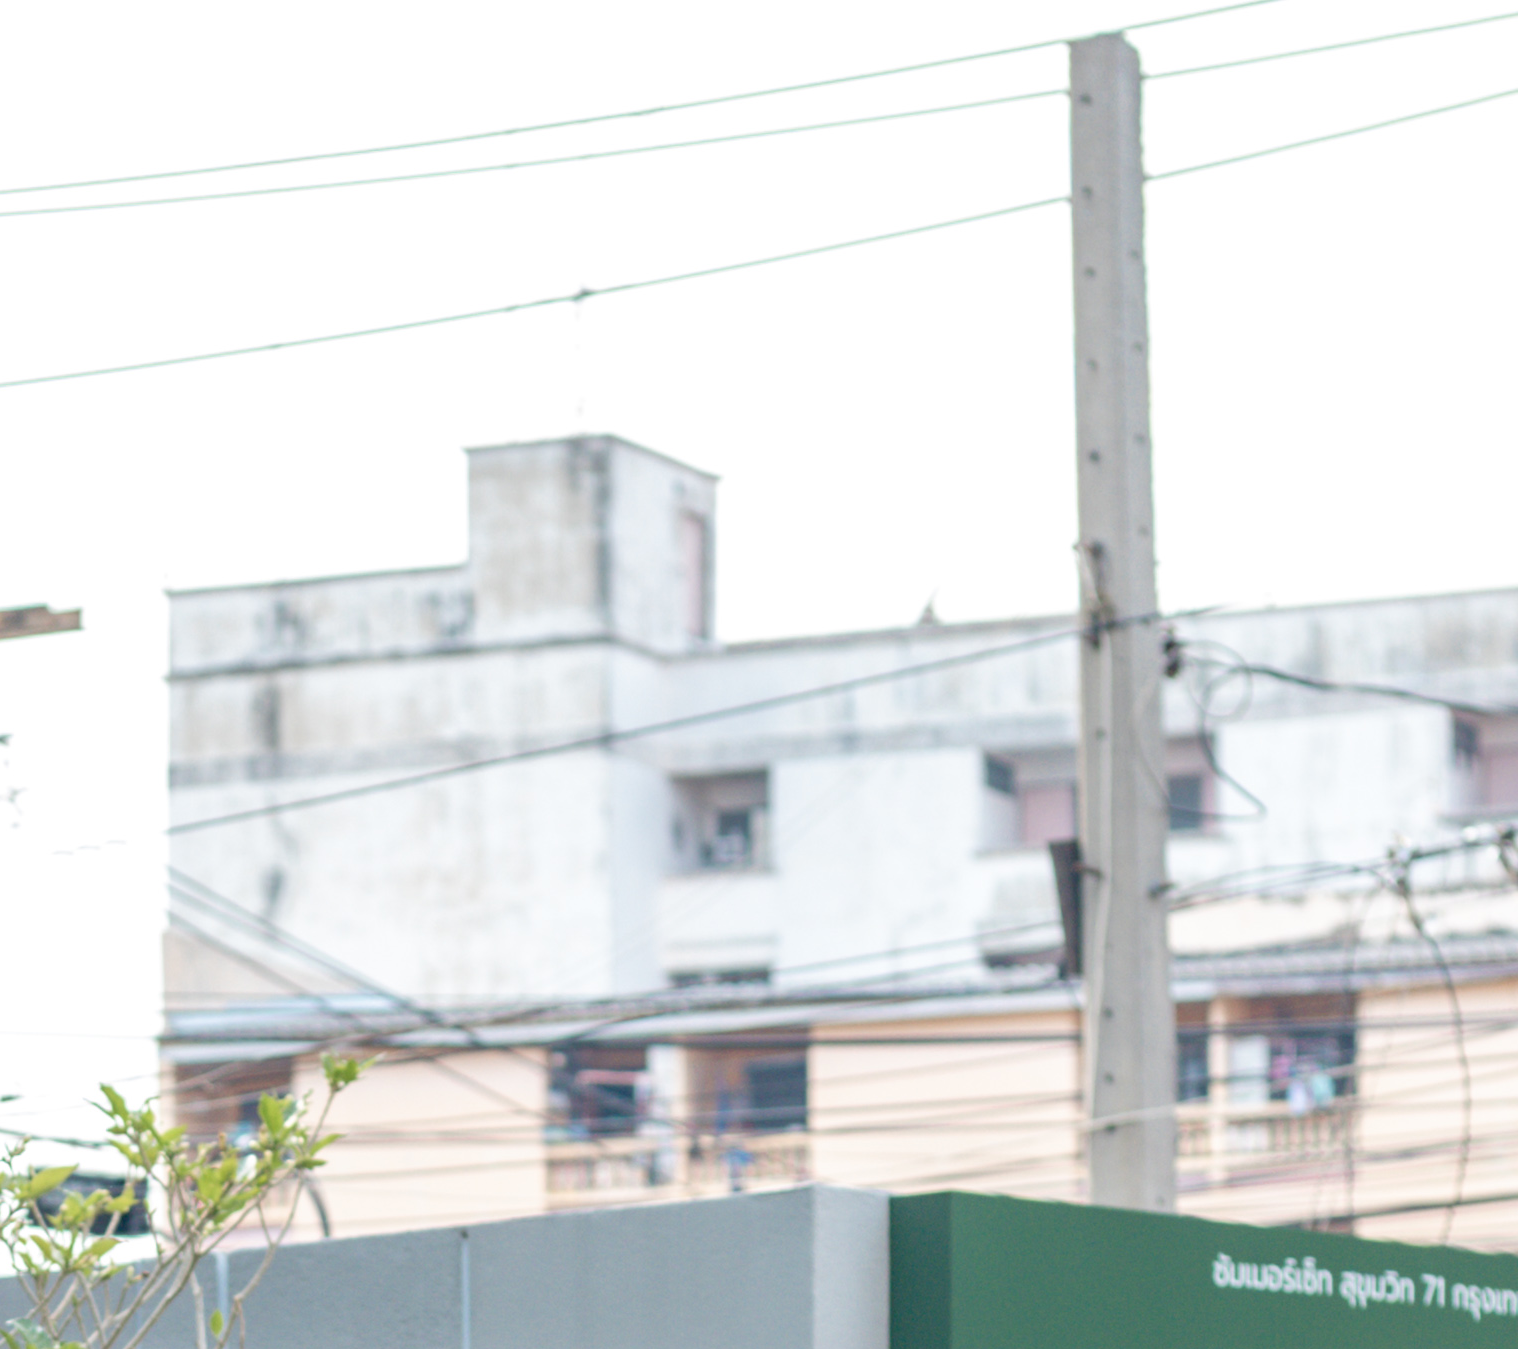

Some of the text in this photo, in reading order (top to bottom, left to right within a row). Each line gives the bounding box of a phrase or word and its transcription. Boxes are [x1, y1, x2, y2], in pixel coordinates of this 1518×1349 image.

[1339, 1270, 1416, 1309] สุขุมวิท
[1421, 1273, 1446, 1307] 71
